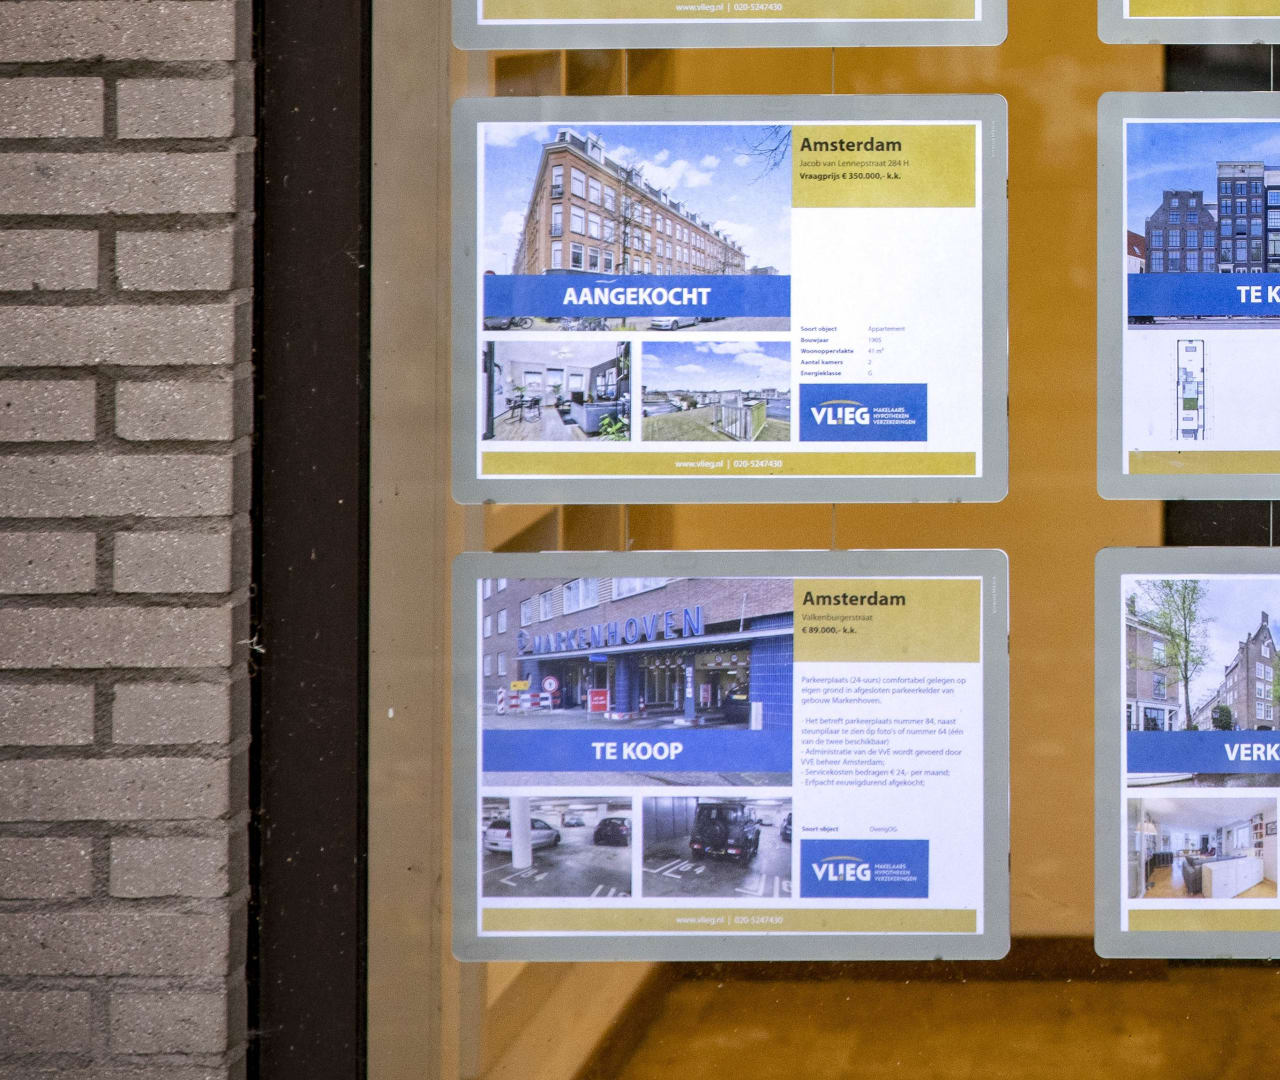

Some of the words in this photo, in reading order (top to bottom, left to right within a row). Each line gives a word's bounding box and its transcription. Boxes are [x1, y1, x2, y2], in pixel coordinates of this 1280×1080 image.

[800, 137, 902, 152] Amsterdam
[838, 160, 886, 168] Lennepstraat
[888, 159, 902, 167] 284
[799, 172, 840, 181] Vraagprijs
[848, 172, 885, 180] 350.000,-
[563, 287, 711, 305] AANGEKOCHT
[1236, 286, 1262, 303] TE
[811, 407, 870, 425] VLIEG
[803, 591, 906, 606] Amsterdam
[801, 613, 873, 623] Valkenburgerstraat
[808, 626, 841, 634] 89.000,-
[591, 742, 617, 760] TE
[623, 742, 683, 760] KOOP
[812, 863, 871, 881] VLIEG
